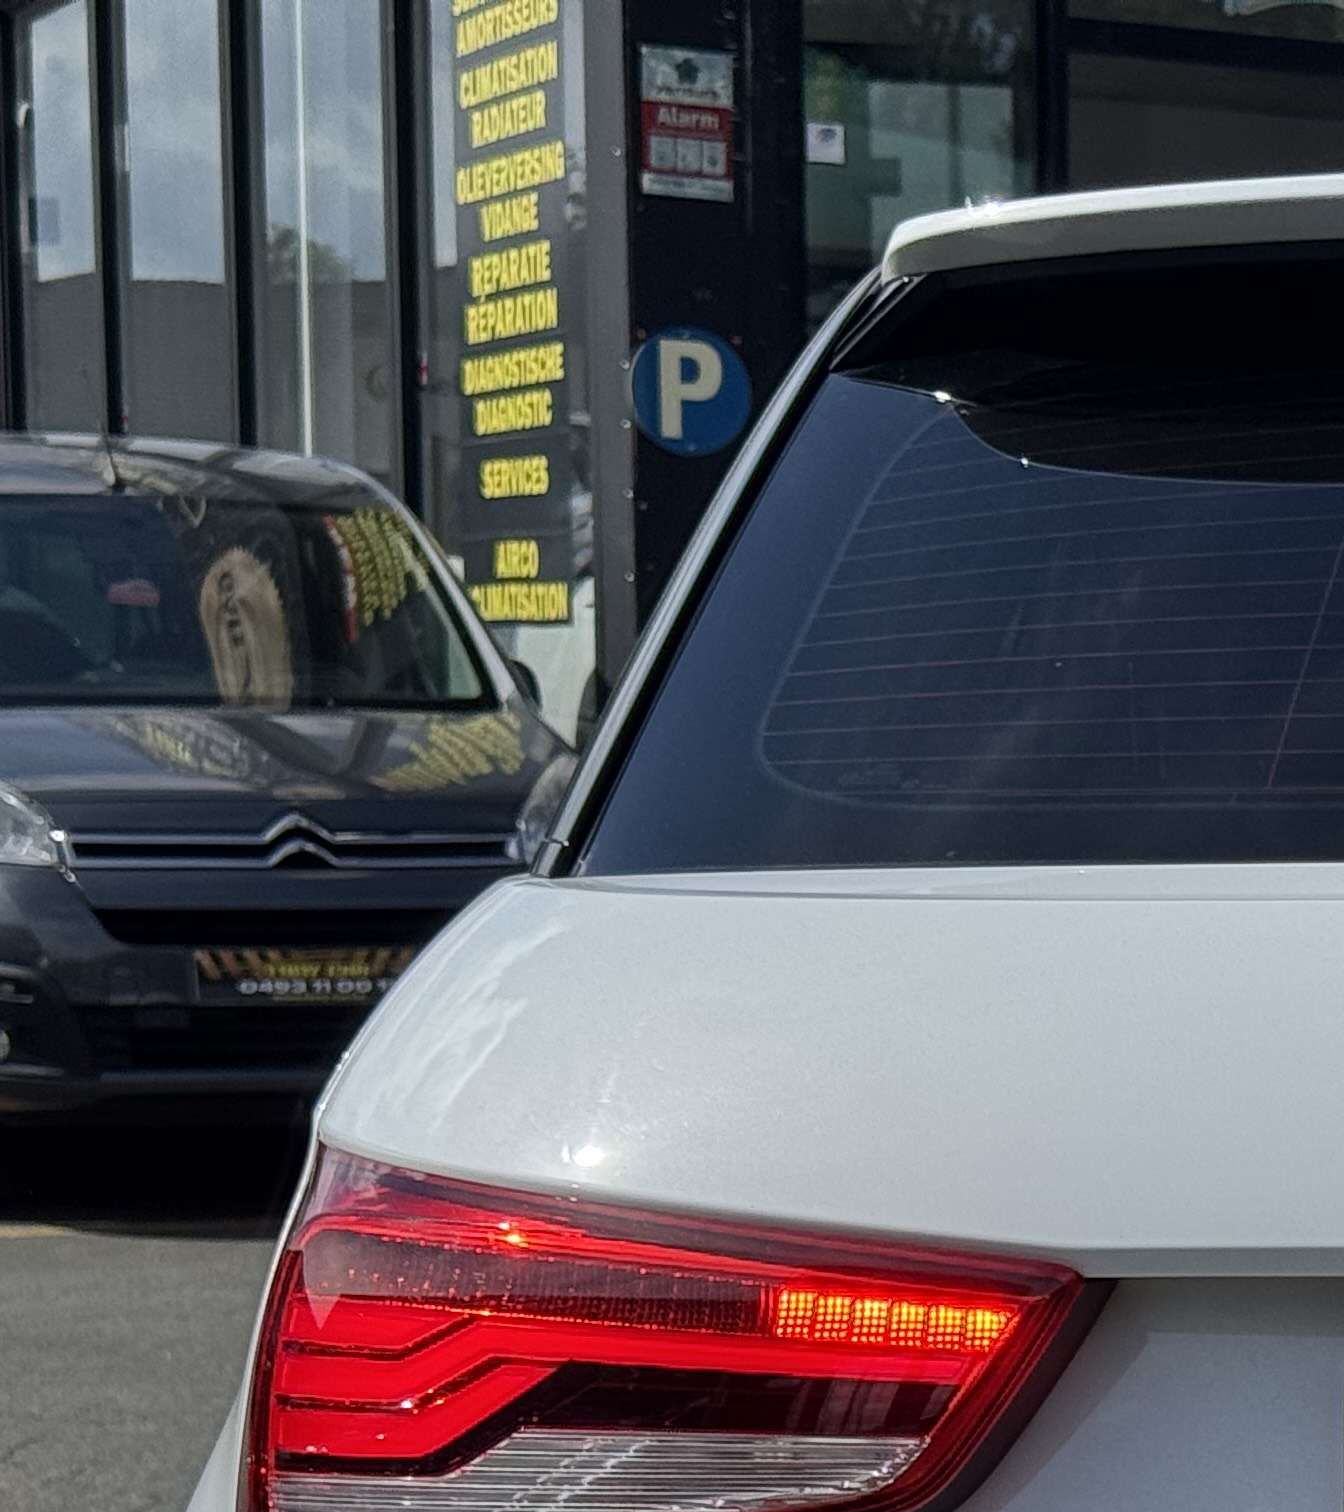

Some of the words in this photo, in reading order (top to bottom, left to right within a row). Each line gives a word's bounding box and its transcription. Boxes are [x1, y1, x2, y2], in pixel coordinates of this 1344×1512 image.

[456, 0, 558, 58] AMORTISSEURS
[459, 40, 558, 110] CLIMATISATION
[472, 89, 546, 149] RADIATEUR
[657, 106, 720, 130] Alarm
[456, 140, 565, 206] OLIEVERVERSING
[481, 191, 539, 242] VIDANGE
[471, 240, 551, 298] REPARATIE
[463, 341, 565, 397] DIAGNOSTISCHE
[474, 388, 553, 436] DIAGNOSTIC
[480, 455, 549, 500] SERVICES
[496, 539, 540, 580] AIRCO
